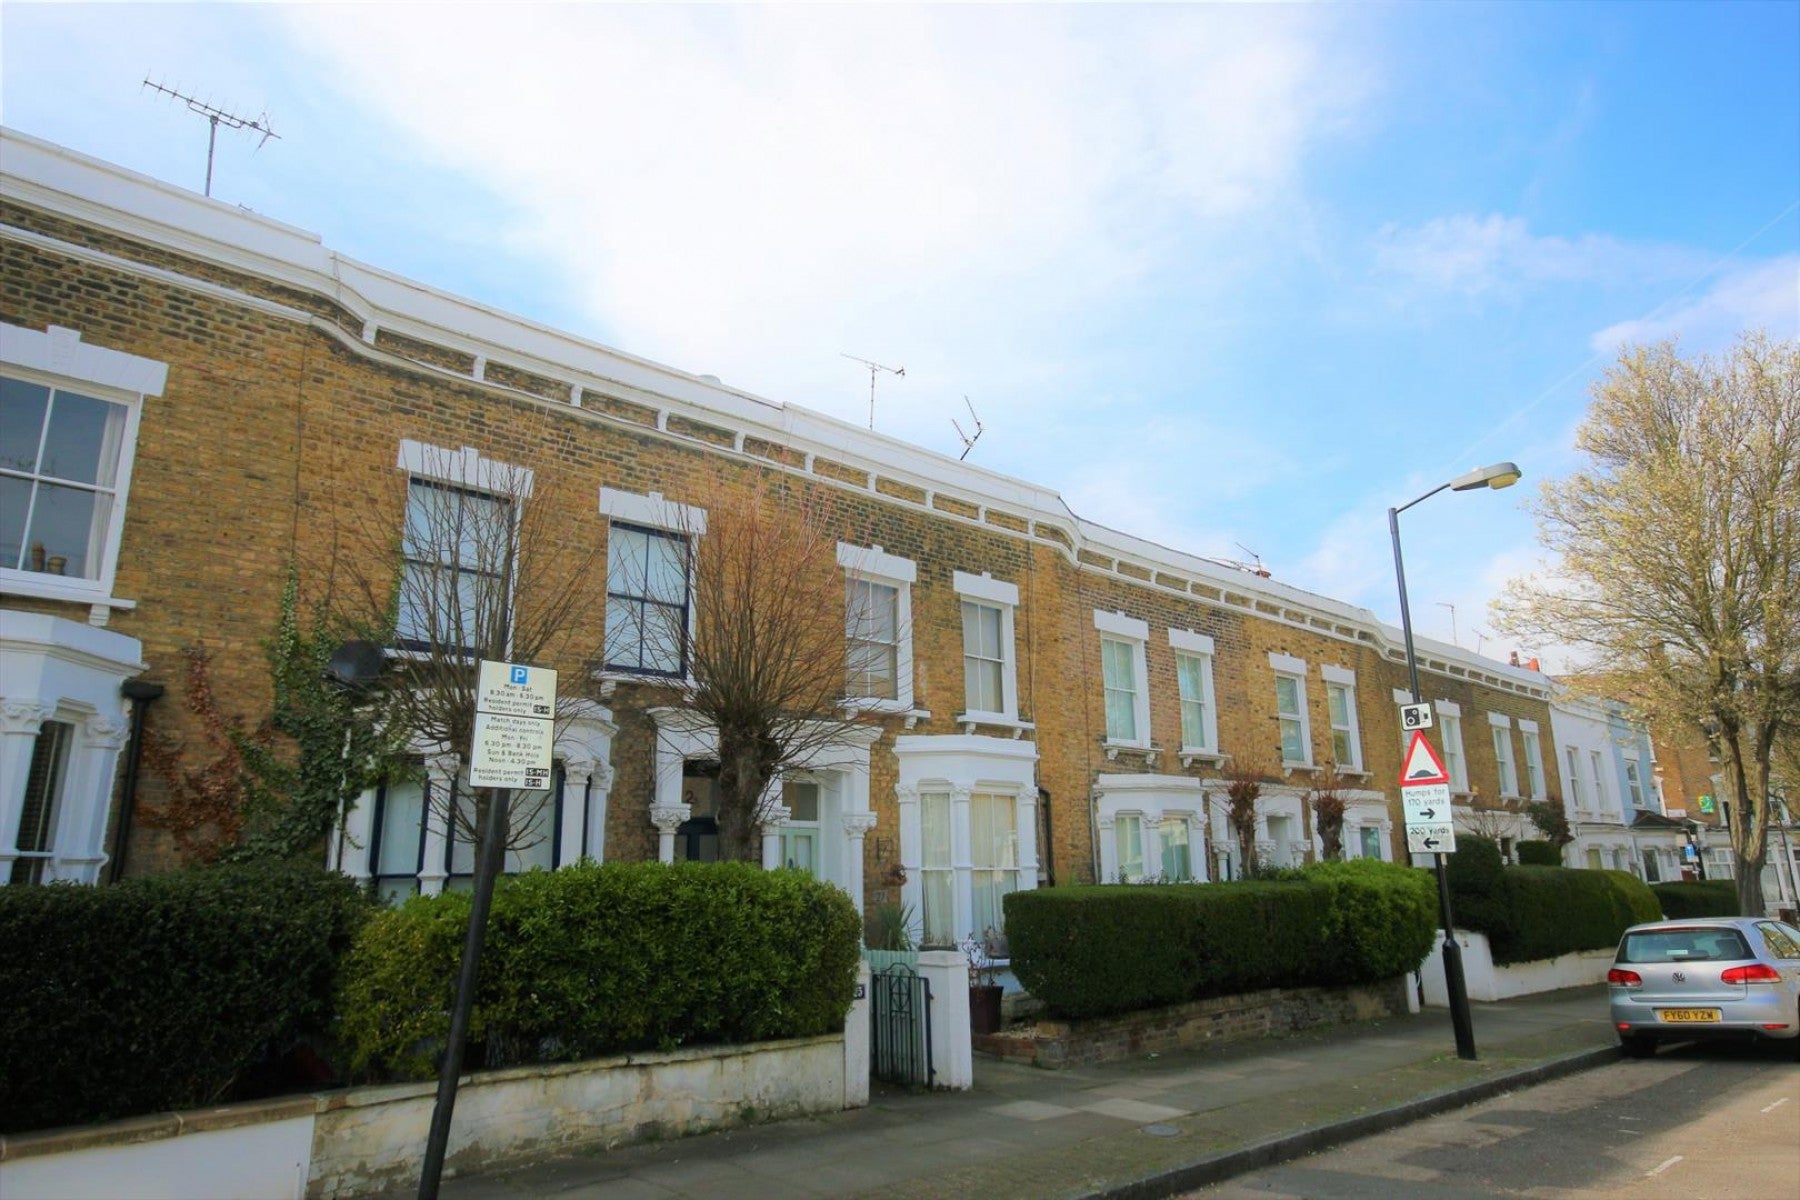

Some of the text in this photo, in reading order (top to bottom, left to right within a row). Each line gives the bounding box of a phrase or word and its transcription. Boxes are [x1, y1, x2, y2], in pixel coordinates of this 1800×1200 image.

[514, 668, 525, 682] P
[1405, 790, 1430, 798] Humps
[1407, 798, 1446, 807] 170 yards
[1409, 826, 1450, 836] 200 yards
[1663, 1010, 1691, 1020] FY60
